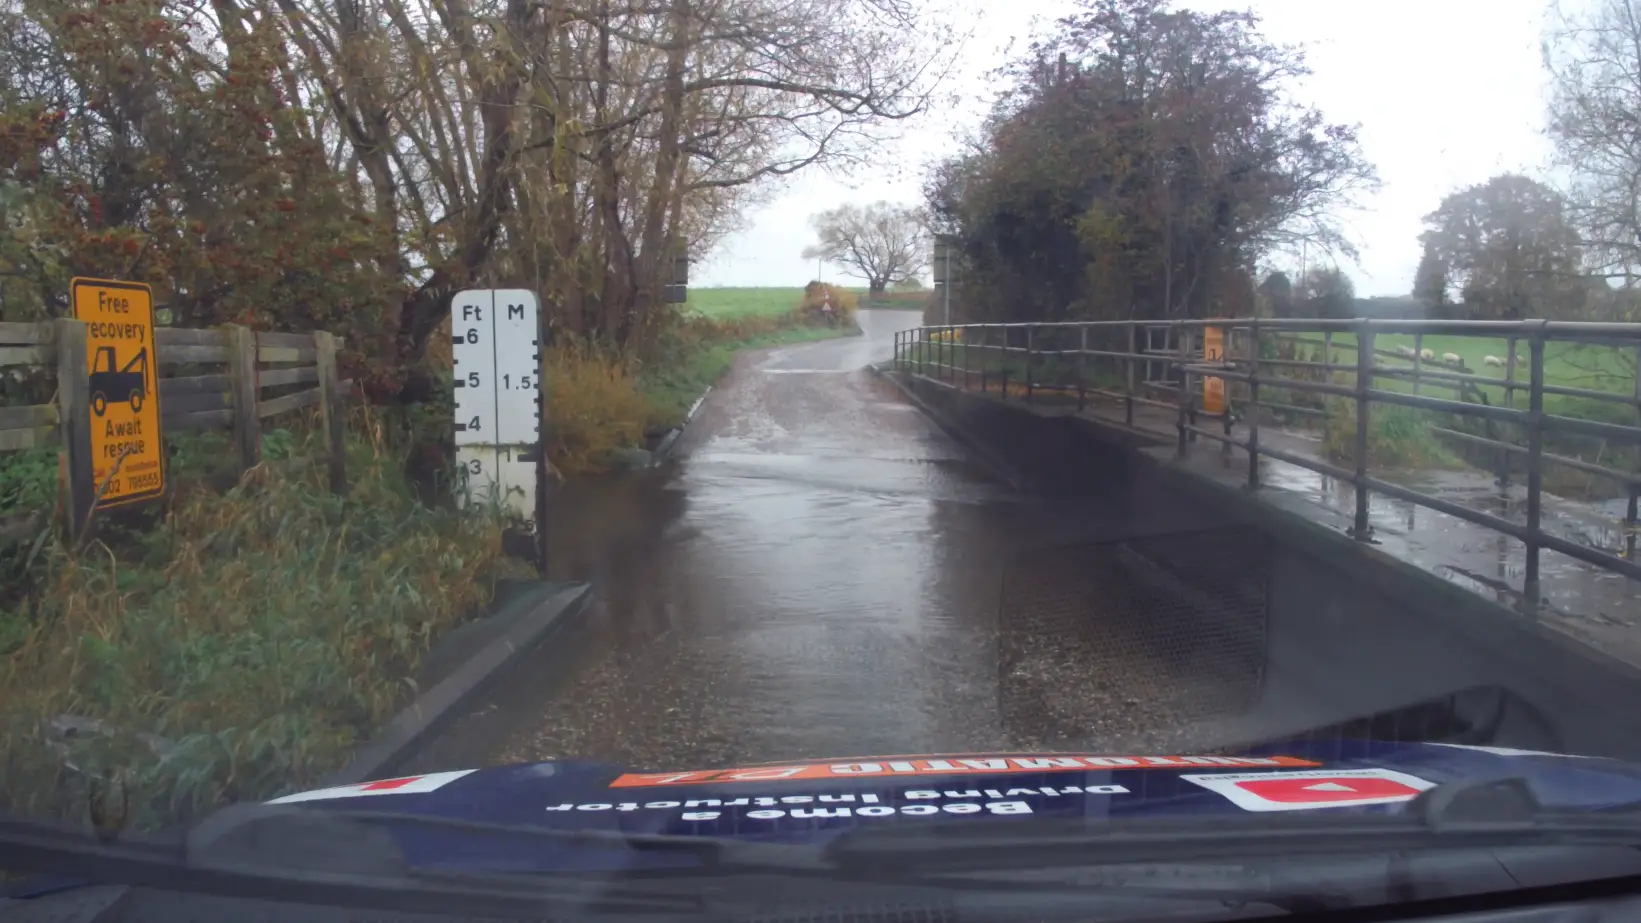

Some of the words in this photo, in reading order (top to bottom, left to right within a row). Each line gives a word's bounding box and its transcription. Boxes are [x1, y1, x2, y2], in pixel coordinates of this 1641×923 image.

[98, 290, 130, 314] Free
[462, 305, 483, 322] Ft
[507, 304, 525, 321] M
[466, 328, 479, 345] 6
[468, 371, 480, 389] 5
[502, 373, 531, 390] 1.5
[105, 418, 142, 438] Await
[468, 415, 482, 432] 4
[103, 438, 145, 459] rescue
[469, 458, 482, 476] 3
[829, 755, 1281, 774] AUTOMATIC
[904, 784, 1131, 800] Driving
[546, 793, 880, 811] Instructor
[747, 800, 1034, 819] Become
[681, 811, 722, 821] a
